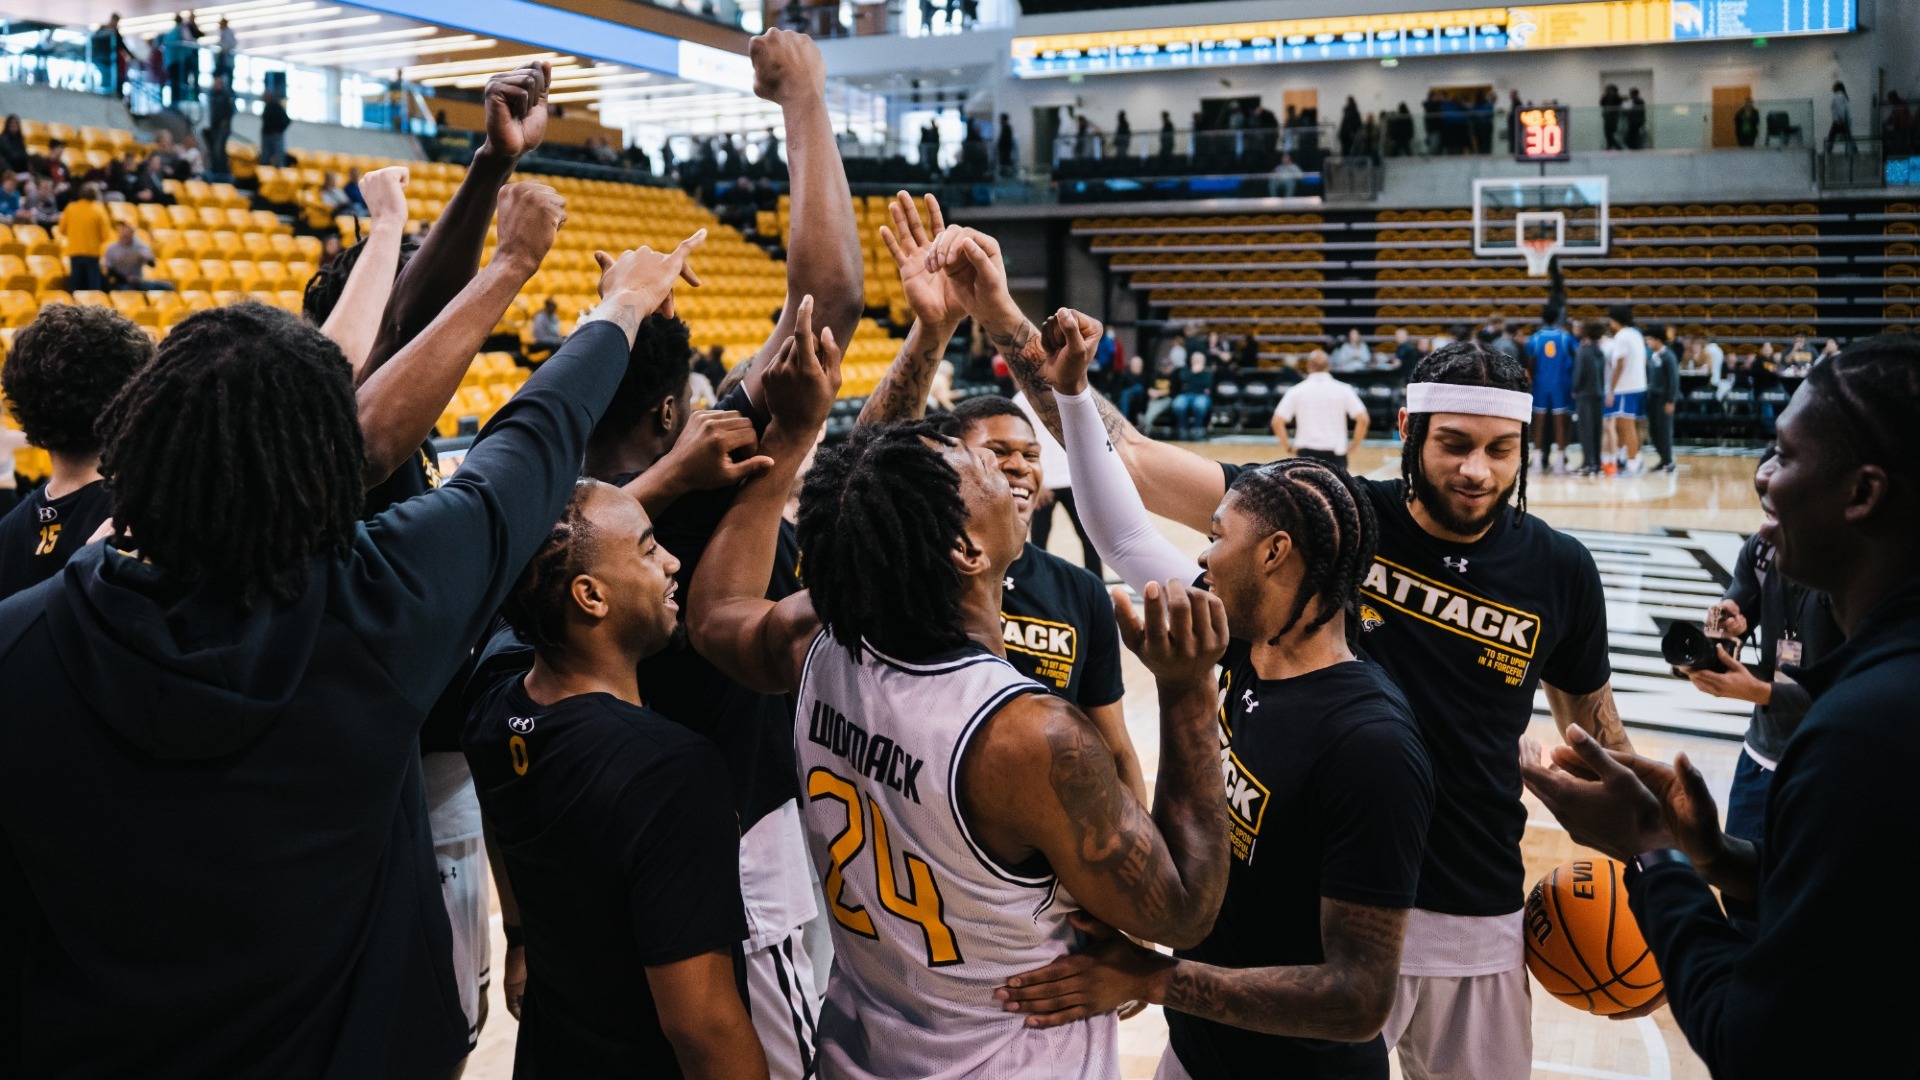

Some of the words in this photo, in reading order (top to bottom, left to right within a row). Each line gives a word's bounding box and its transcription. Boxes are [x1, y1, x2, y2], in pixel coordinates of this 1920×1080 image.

[1525, 125, 1562, 155] 30
[35, 523, 62, 556] 15
[1362, 562, 1534, 649] ATTACK
[1001, 616, 1072, 656] ACK
[1477, 655, 1487, 666] IN
[1493, 661, 1524, 678] FORCEFUL
[1496, 652, 1510, 663] SET
[1510, 656, 1527, 669] UPON
[509, 735, 529, 776] 0
[808, 700, 924, 805] WOMACK
[1230, 831, 1249, 855] RCEFUL
[807, 766, 965, 967] 24
[1573, 861, 1595, 900] EVO
